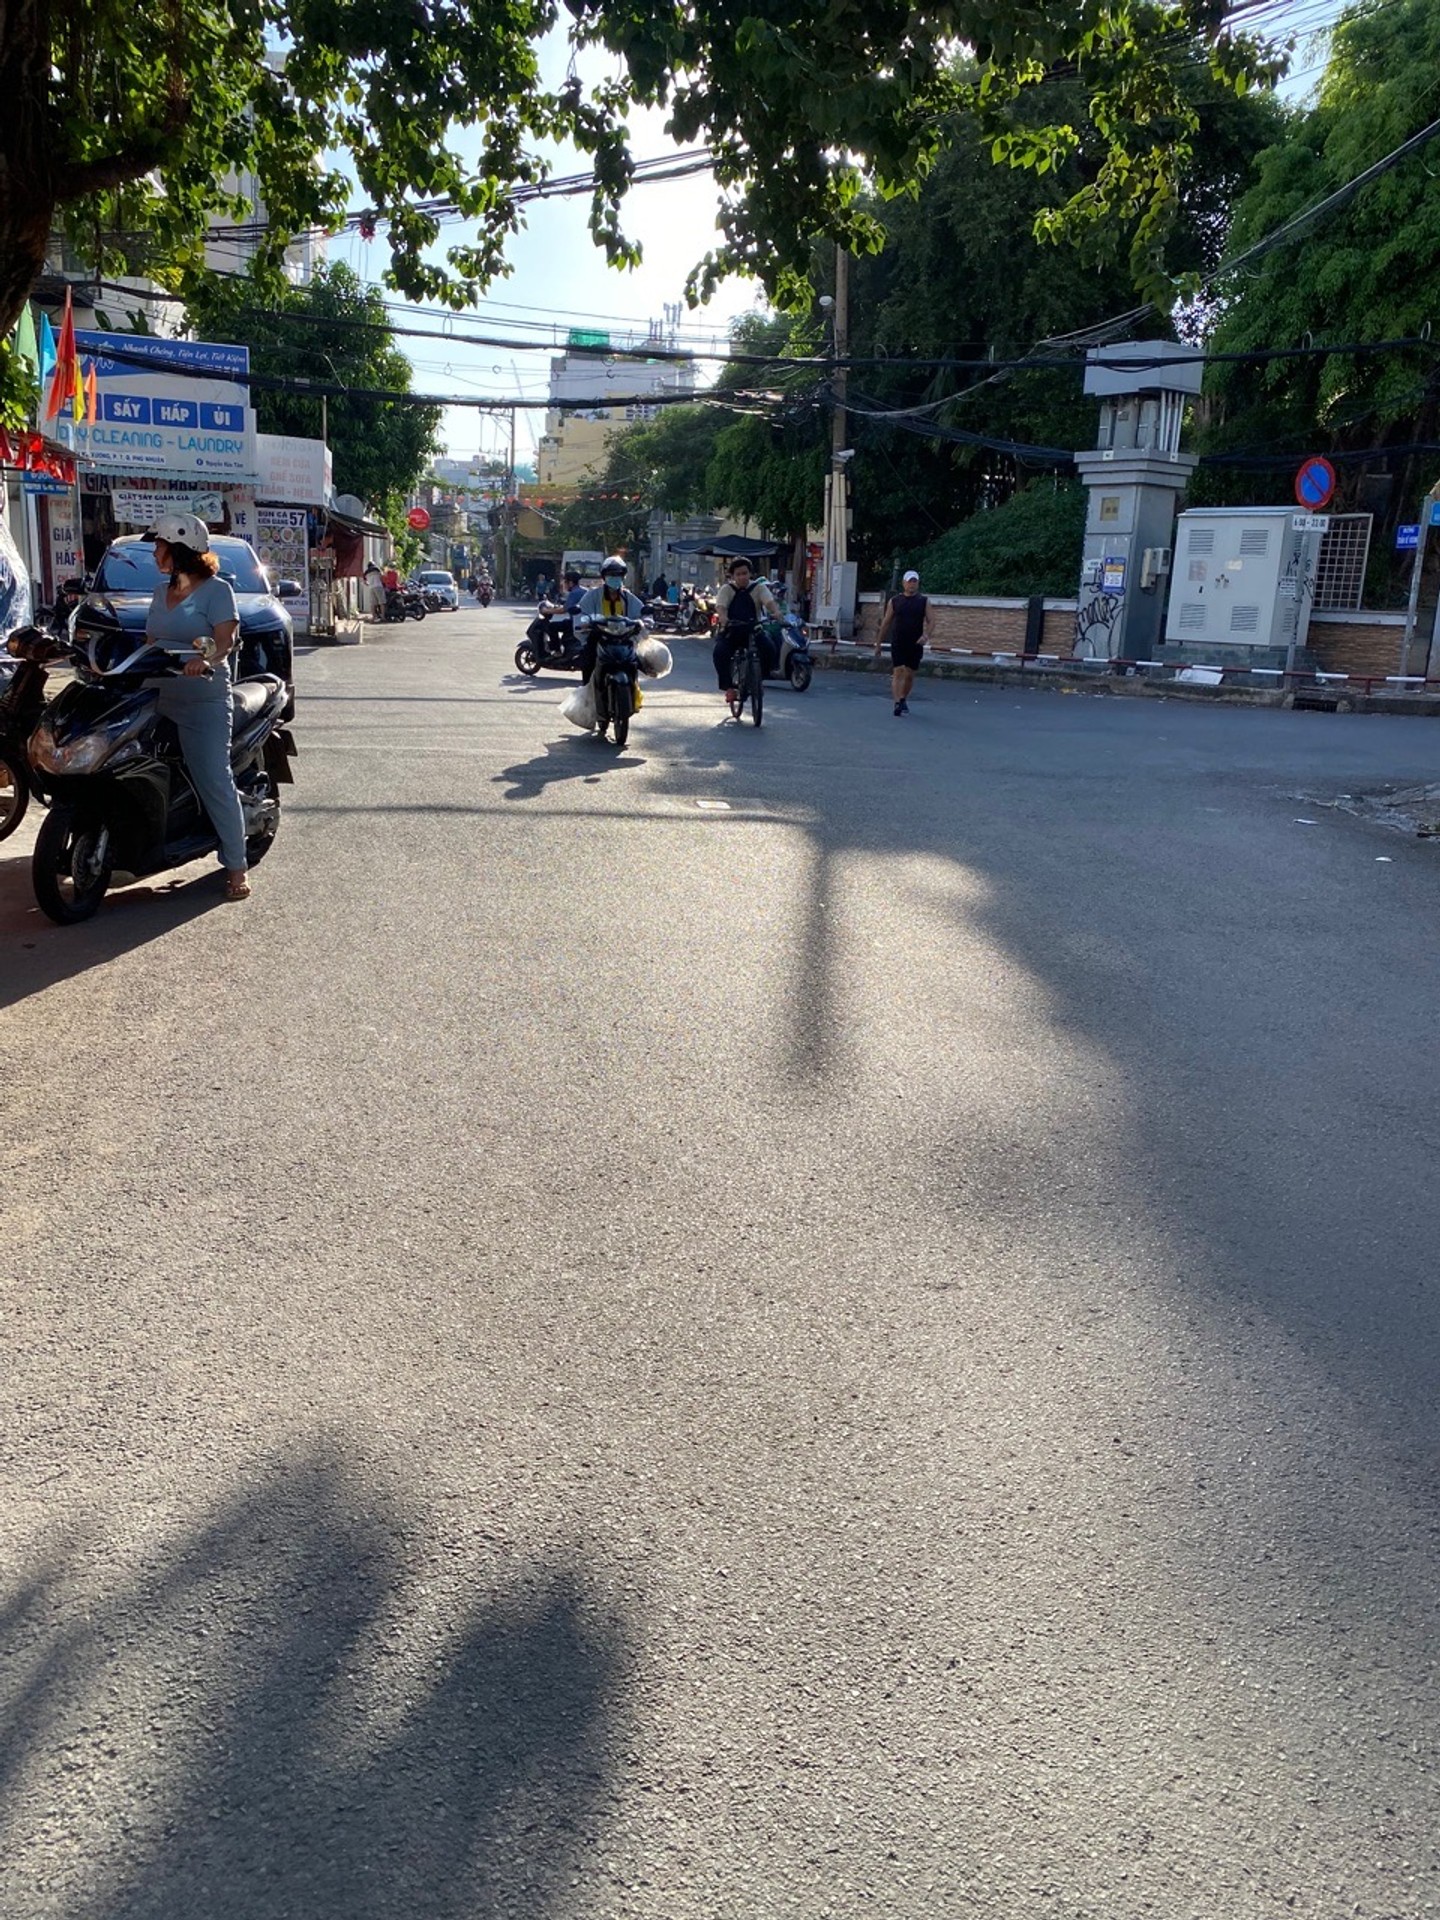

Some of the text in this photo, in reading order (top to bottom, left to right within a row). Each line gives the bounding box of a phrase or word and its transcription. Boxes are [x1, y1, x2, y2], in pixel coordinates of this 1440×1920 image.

[122, 343, 148, 354] Nhanh
[113, 399, 141, 419] SẤY
[160, 401, 190, 423] HẤP
[213, 405, 231, 426] ỦI
[92, 428, 162, 449] CLEANING
[178, 433, 244, 454] LAUNDRY
[234, 510, 247, 527] VỆ
[289, 511, 306, 526] 57
